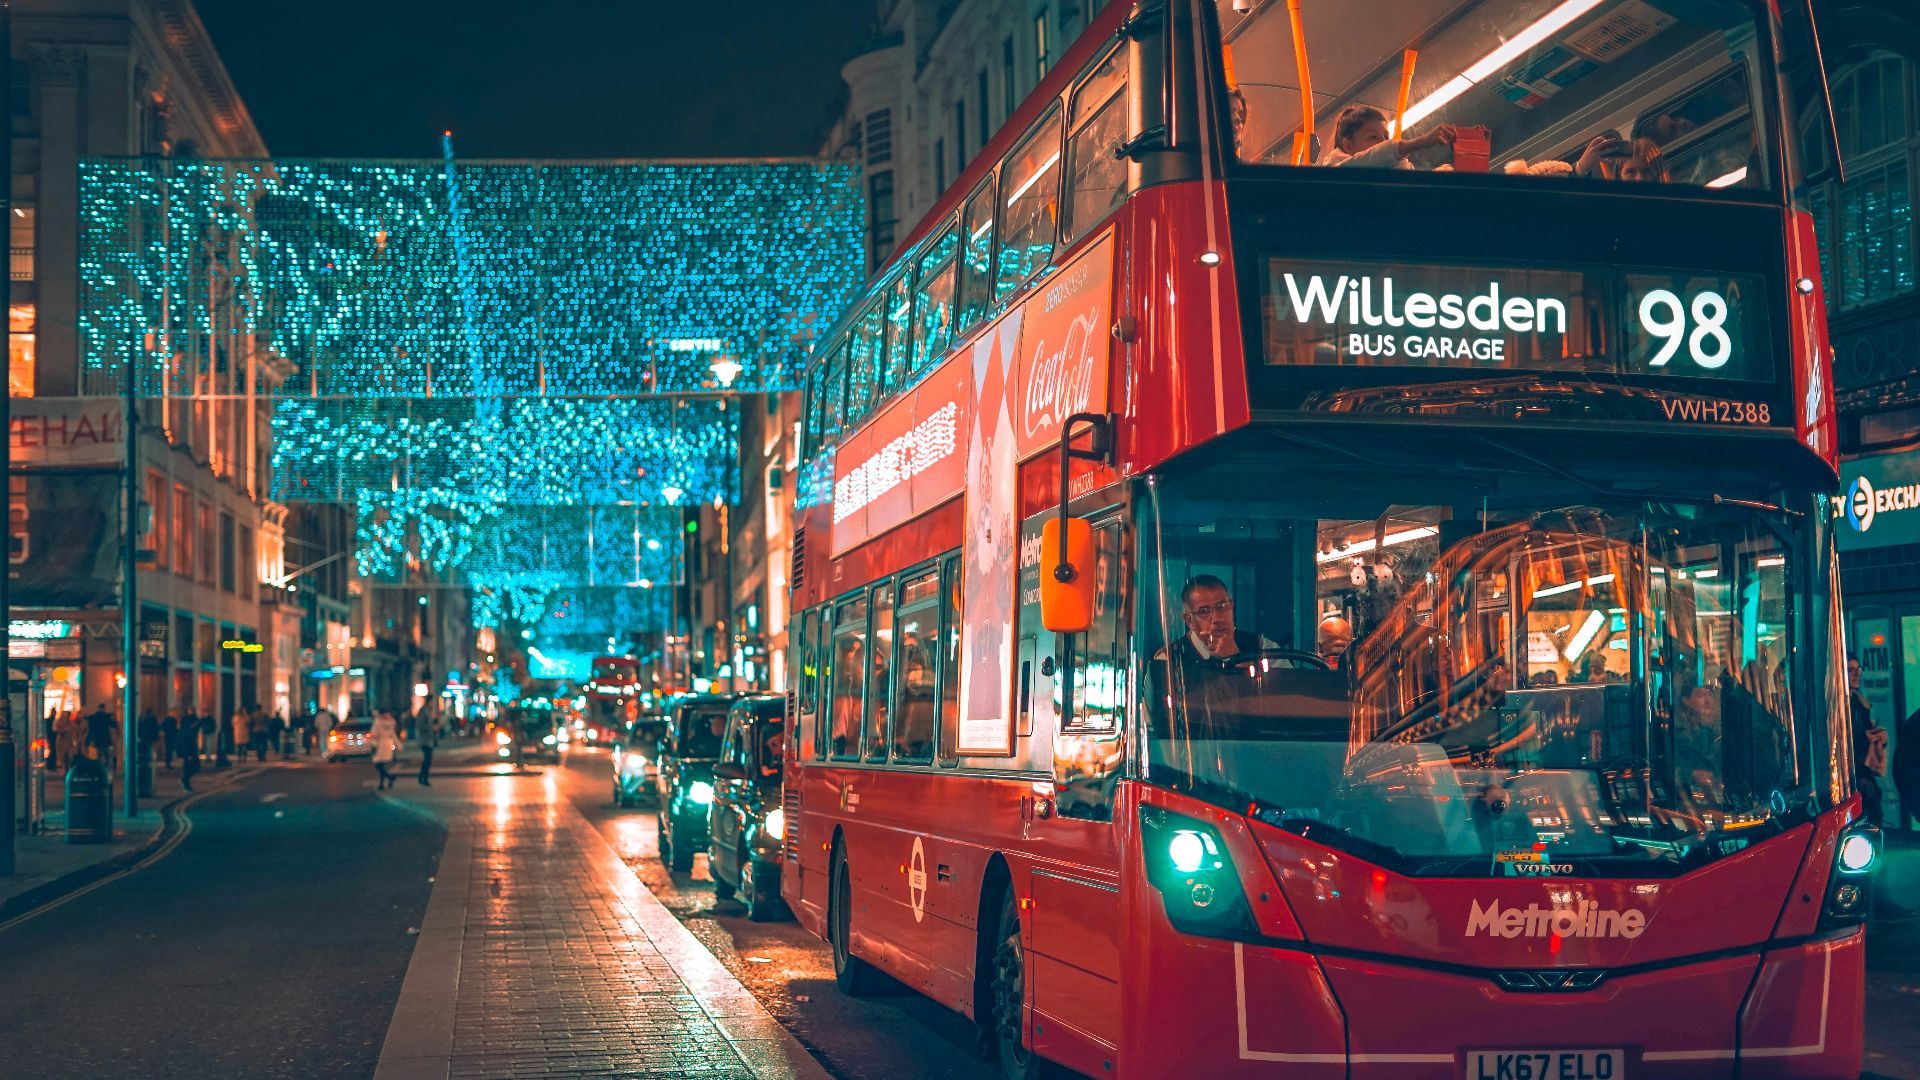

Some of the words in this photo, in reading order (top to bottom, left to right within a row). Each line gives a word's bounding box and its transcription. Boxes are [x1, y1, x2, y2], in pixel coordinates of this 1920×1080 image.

[1284, 273, 1566, 334] Willesden
[1639, 290, 1732, 368] 98
[1350, 334, 1396, 358] BUS
[1404, 336, 1505, 361] GARAGE
[1662, 399, 1771, 424] VWH2388
[1862, 647, 1889, 672] ATM
[1515, 864, 1574, 874] VOLVO
[1465, 897, 1646, 939] Metroline
[1478, 1054, 1551, 1080] LK67
